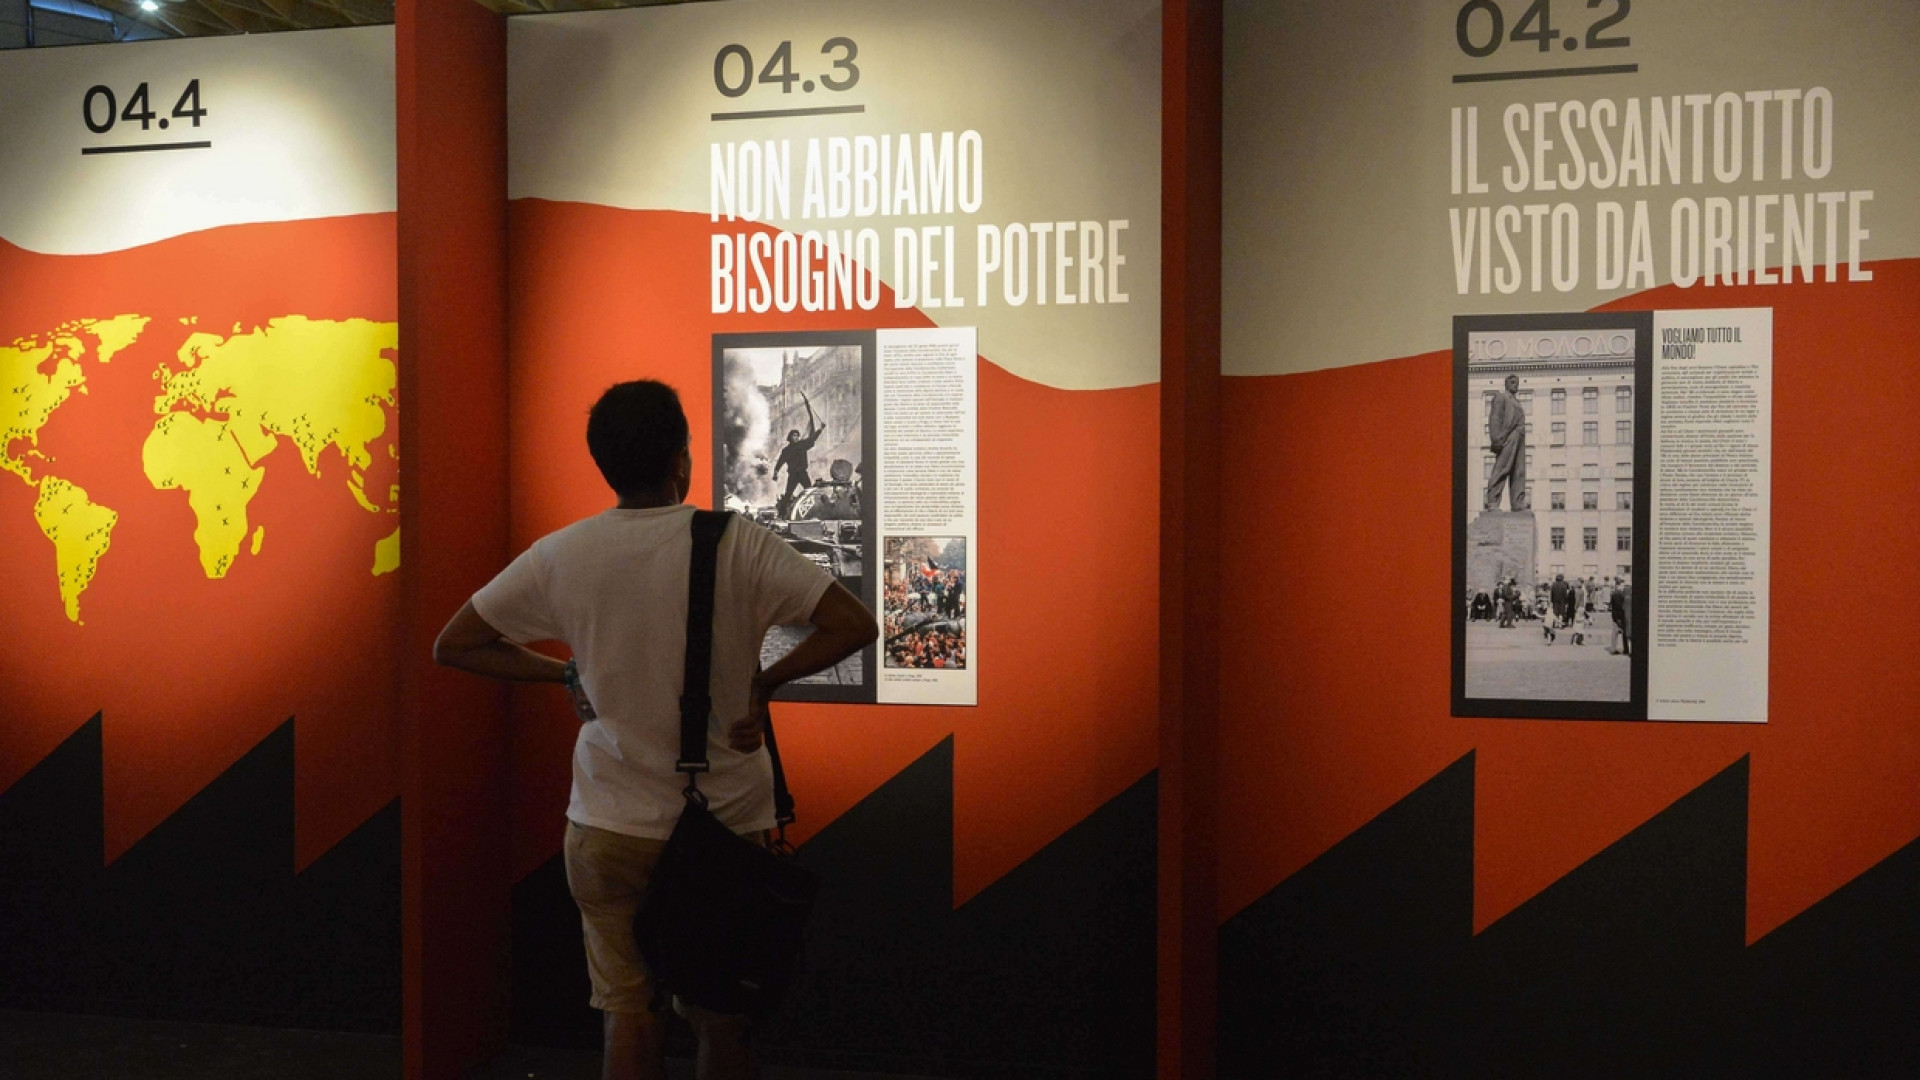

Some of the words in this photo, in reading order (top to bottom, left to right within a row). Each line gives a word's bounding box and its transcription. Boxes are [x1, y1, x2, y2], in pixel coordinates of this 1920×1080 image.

[1456, 0, 1631, 58] 04.2
[713, 36, 860, 98] 04.3
[82, 78, 208, 134] 04.4
[1451, 106, 1489, 194] IL
[1502, 86, 1833, 193] SESSANTOTTO
[711, 139, 790, 223] NON
[802, 129, 983, 220] ABBIAMO
[711, 228, 880, 315] BISOGNO
[894, 224, 964, 309] DEL
[977, 219, 1130, 307] POTERE
[1449, 202, 1580, 295] VISTO
[1596, 201, 1656, 291] DA
[1670, 190, 1874, 289] ORIENTE
[1661, 344, 1696, 359] MONDO!
[1662, 328, 1705, 343] VOGLIAMO
[1707, 327, 1733, 343] TUTTO
[1734, 327, 1742, 343] IL
